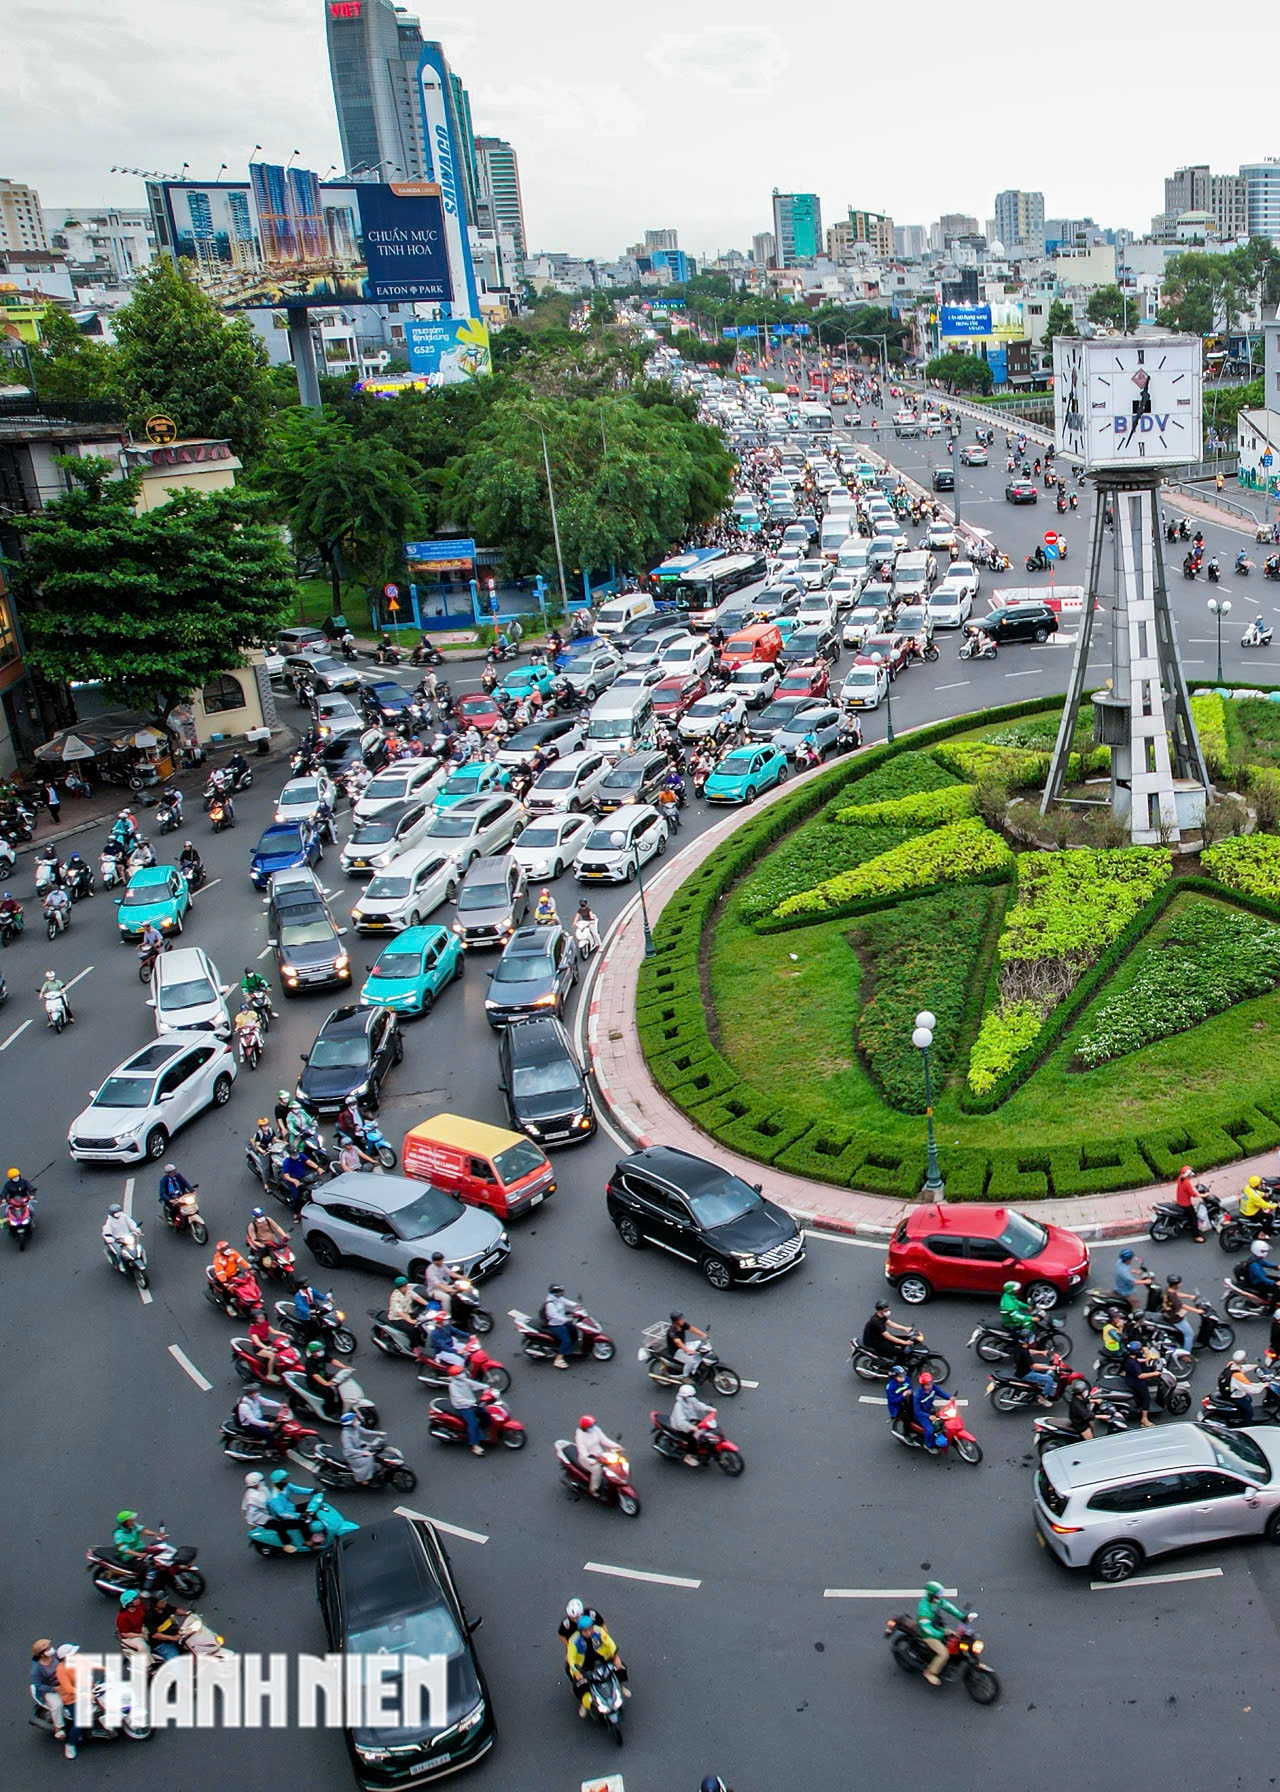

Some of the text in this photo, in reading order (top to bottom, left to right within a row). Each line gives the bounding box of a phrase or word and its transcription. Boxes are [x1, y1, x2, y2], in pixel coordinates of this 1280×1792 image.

[434, 124, 458, 217] SAWACO
[411, 229, 438, 243] MỰC
[377, 244, 432, 256] TINH HOA
[376, 284, 444, 296] EATON PARK
[413, 345, 436, 354] GS25
[1114, 414, 1170, 434] BIDV
